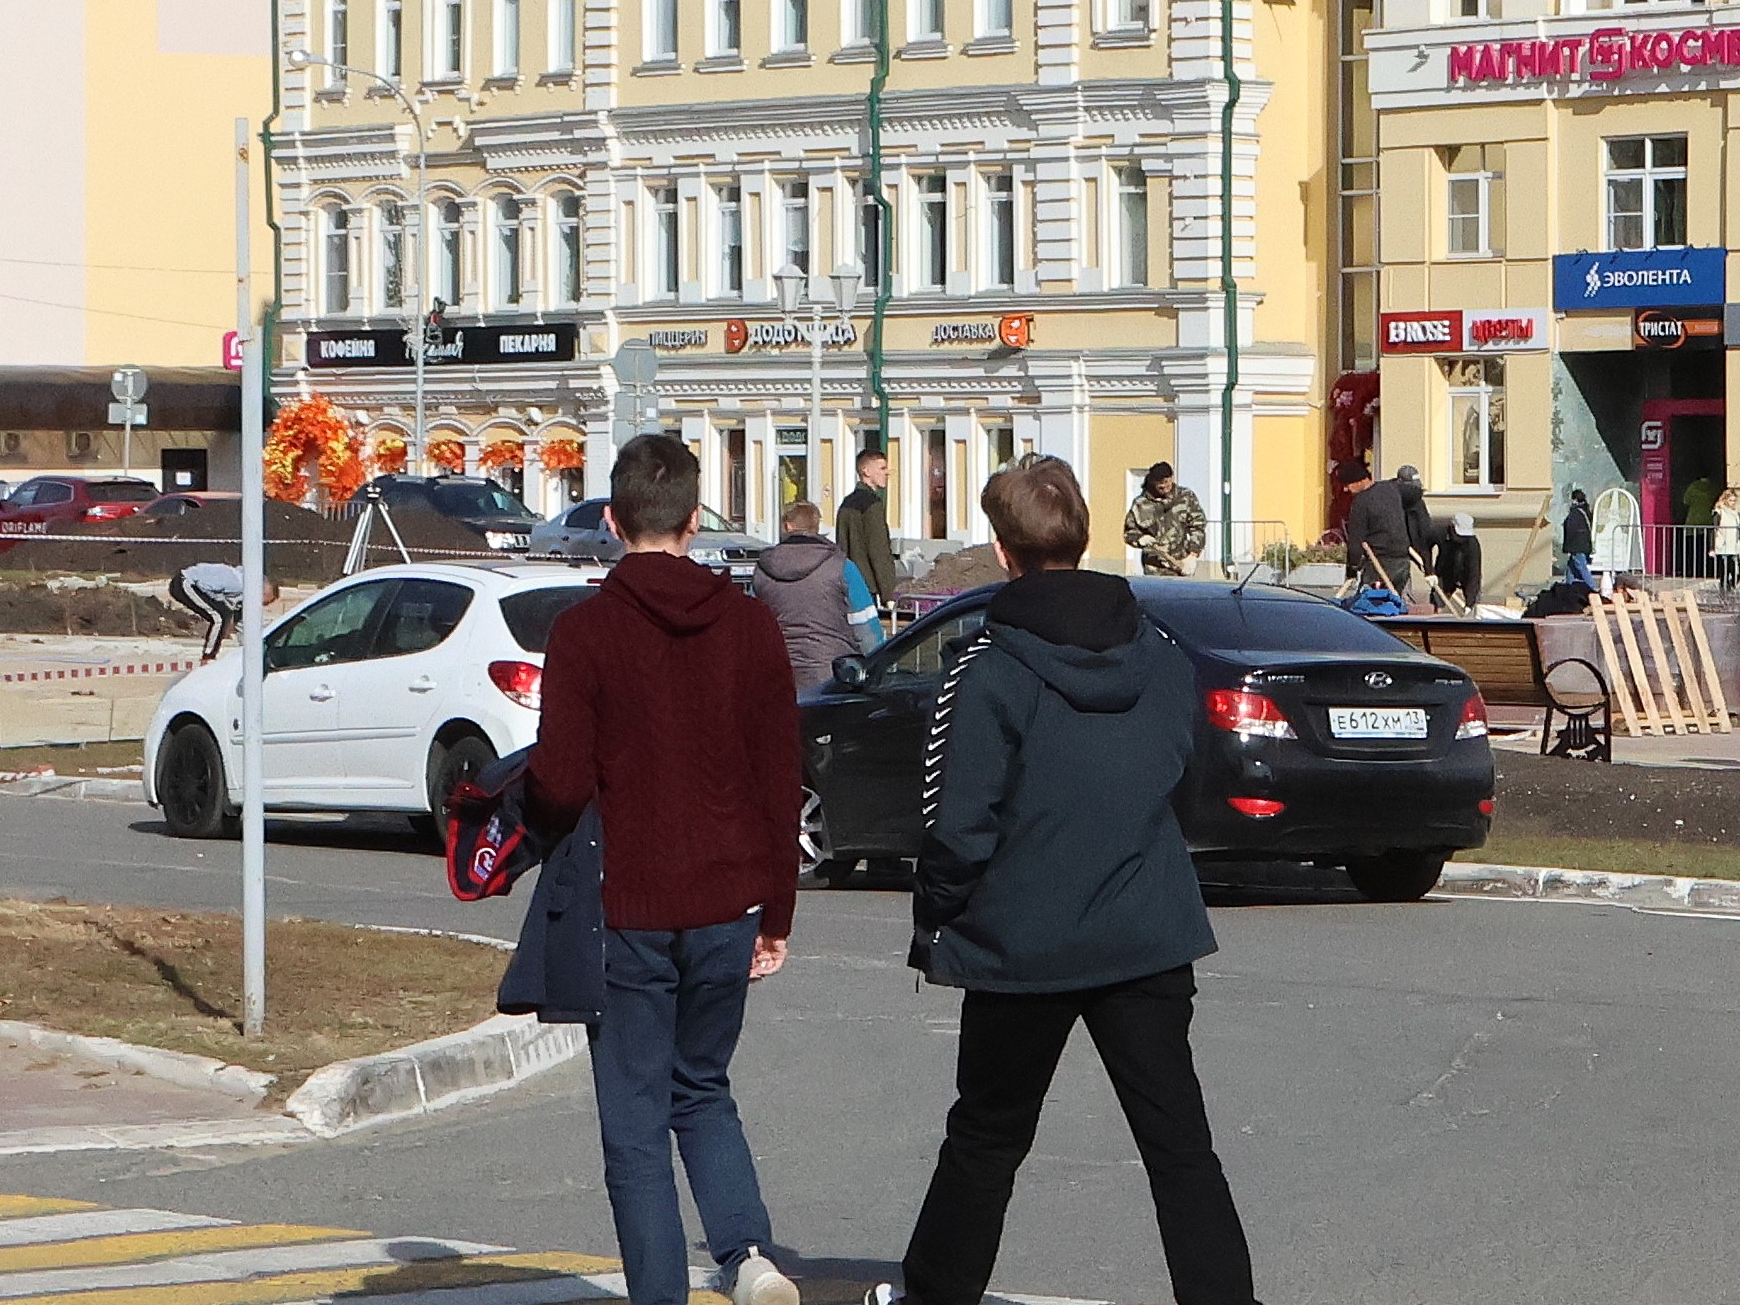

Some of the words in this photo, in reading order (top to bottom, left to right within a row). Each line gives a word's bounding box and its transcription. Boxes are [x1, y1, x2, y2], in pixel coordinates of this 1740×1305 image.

[1449, 38, 1585, 81] МАГНИТ
[1603, 269, 1692, 288] ЭВОЛЕНТА
[649, 329, 709, 348] ПИЦЦЕРИЯ
[750, 324, 797, 345] ДОДО
[931, 322, 996, 343] ДОСТАВКА
[1639, 321, 1684, 337] ТРИСТАТ
[319, 337, 376, 359] КОФЕЙНЯ
[499, 333, 557, 355] ПЕКАРНЯ
[1404, 711, 1420, 724] 13
